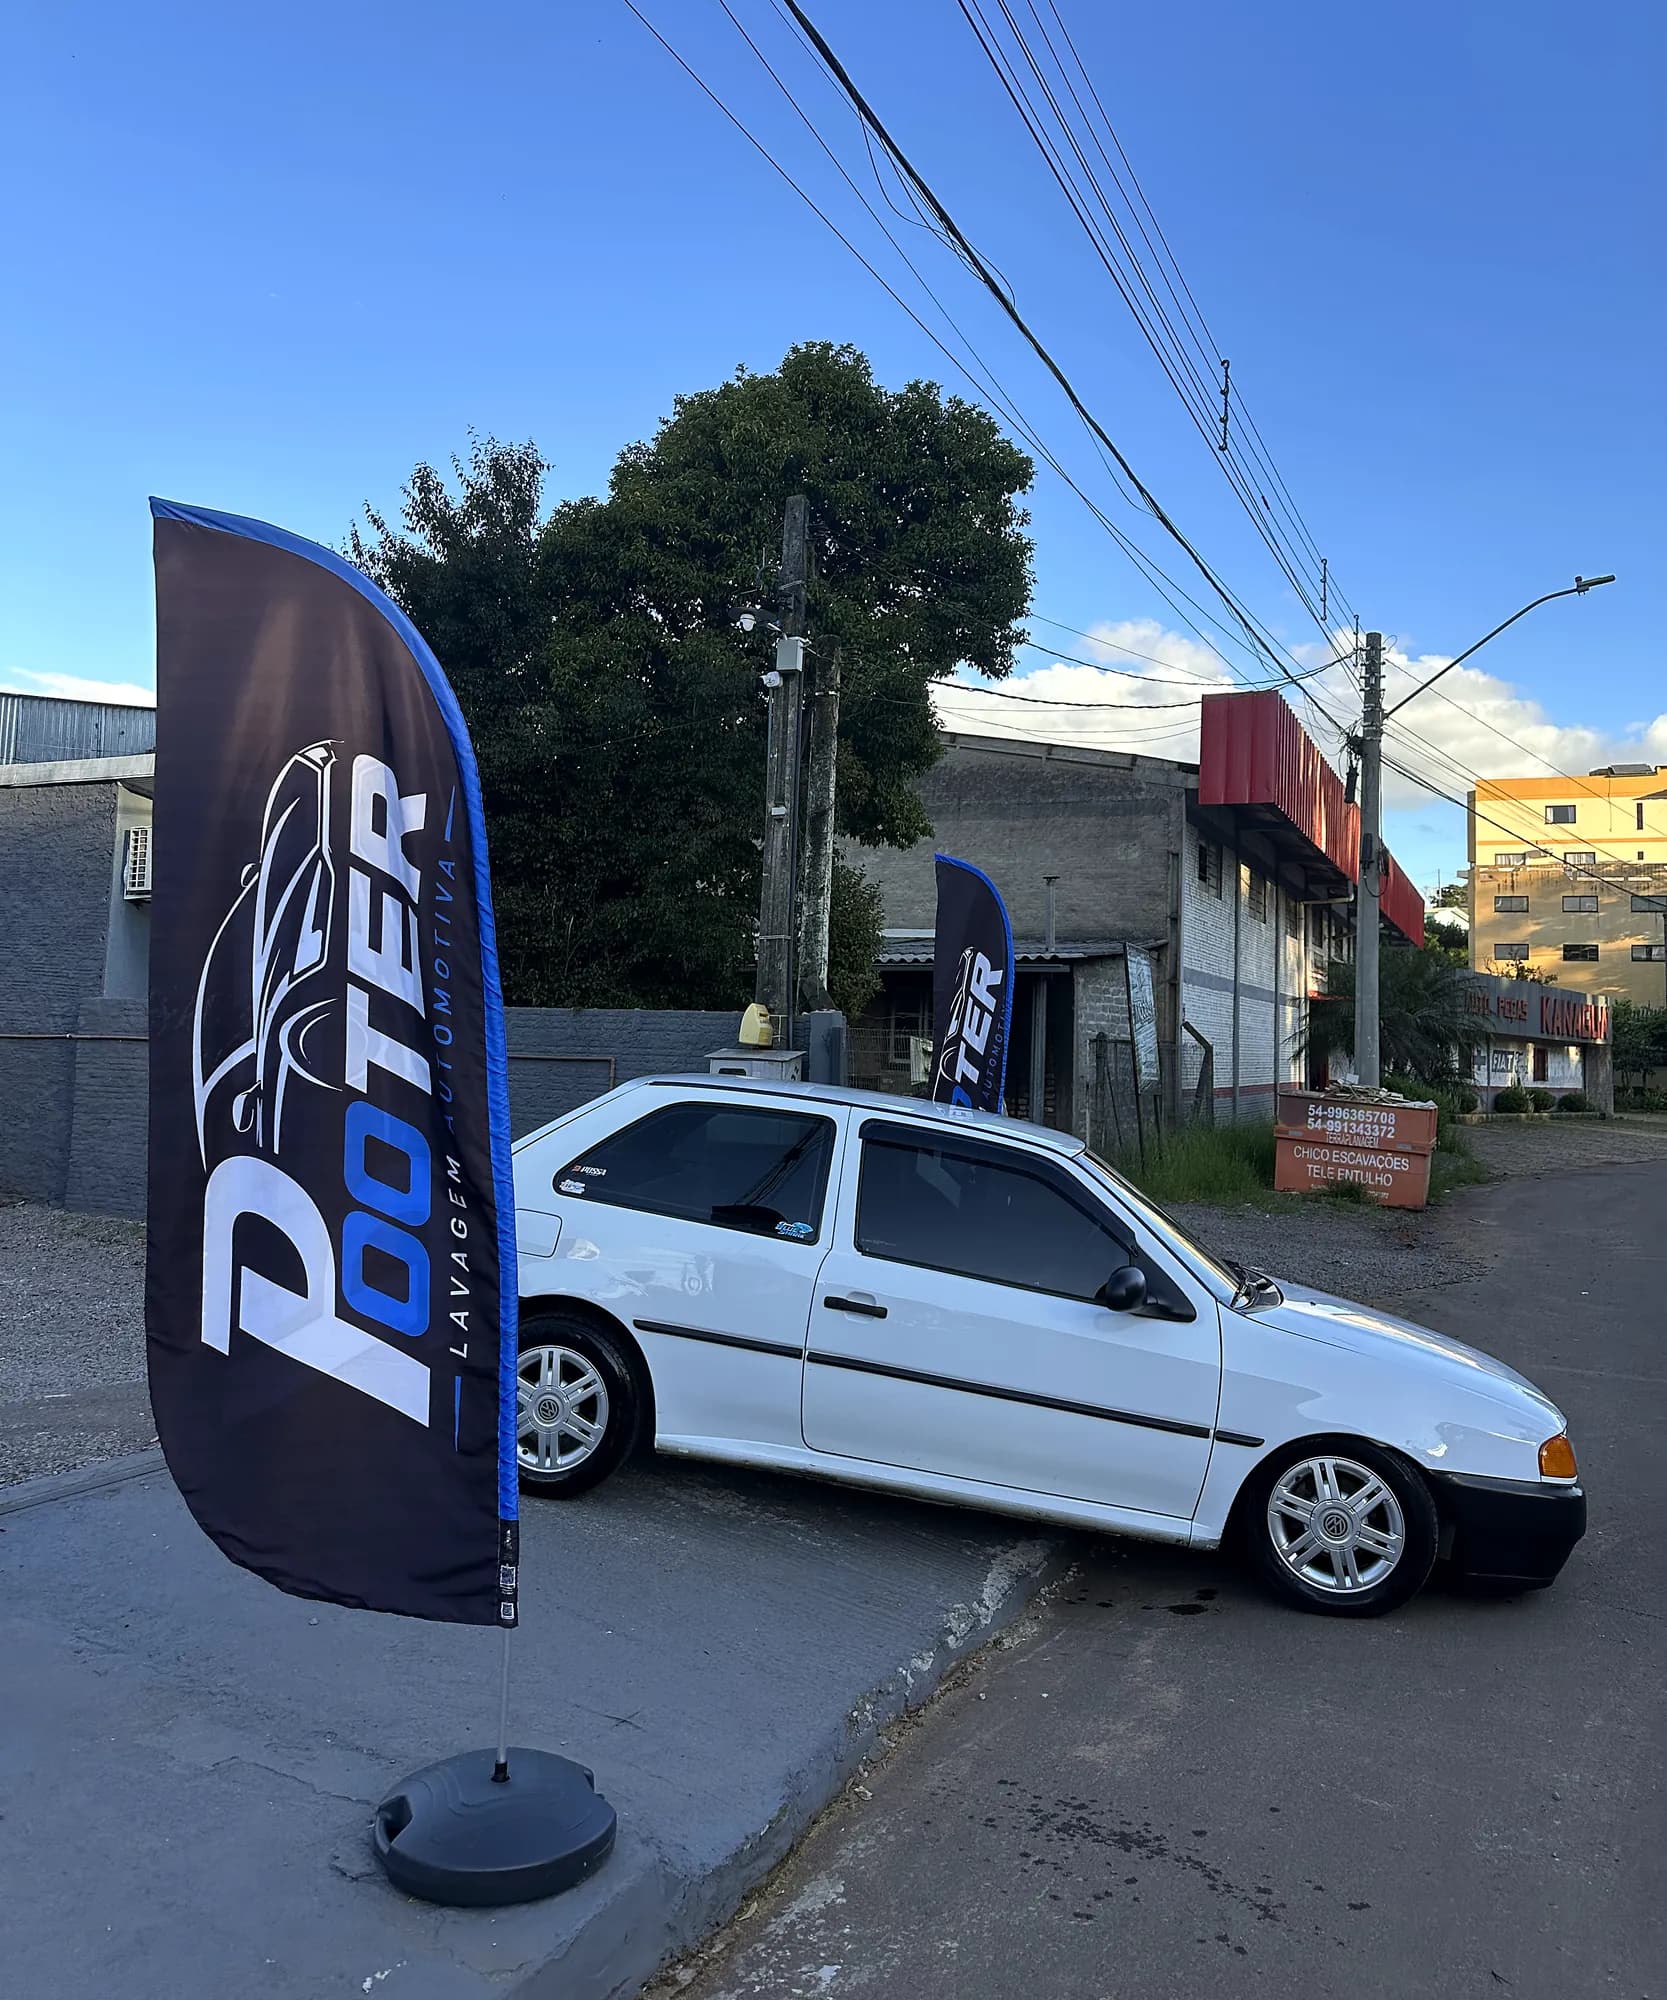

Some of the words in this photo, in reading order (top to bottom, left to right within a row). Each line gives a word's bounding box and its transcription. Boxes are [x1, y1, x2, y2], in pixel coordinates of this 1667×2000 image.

[1308, 1104, 1396, 1125] 54-996365708
[1307, 1118, 1395, 1139] 54-991343372
[1294, 1146, 1330, 1161] CHICO
[1332, 1150, 1410, 1172] ESCAVAÇÕES
[1307, 1164, 1335, 1180] TELE
[1337, 1168, 1393, 1187] ENTULHO
[446, 1155, 470, 1358] LAVAGEM
